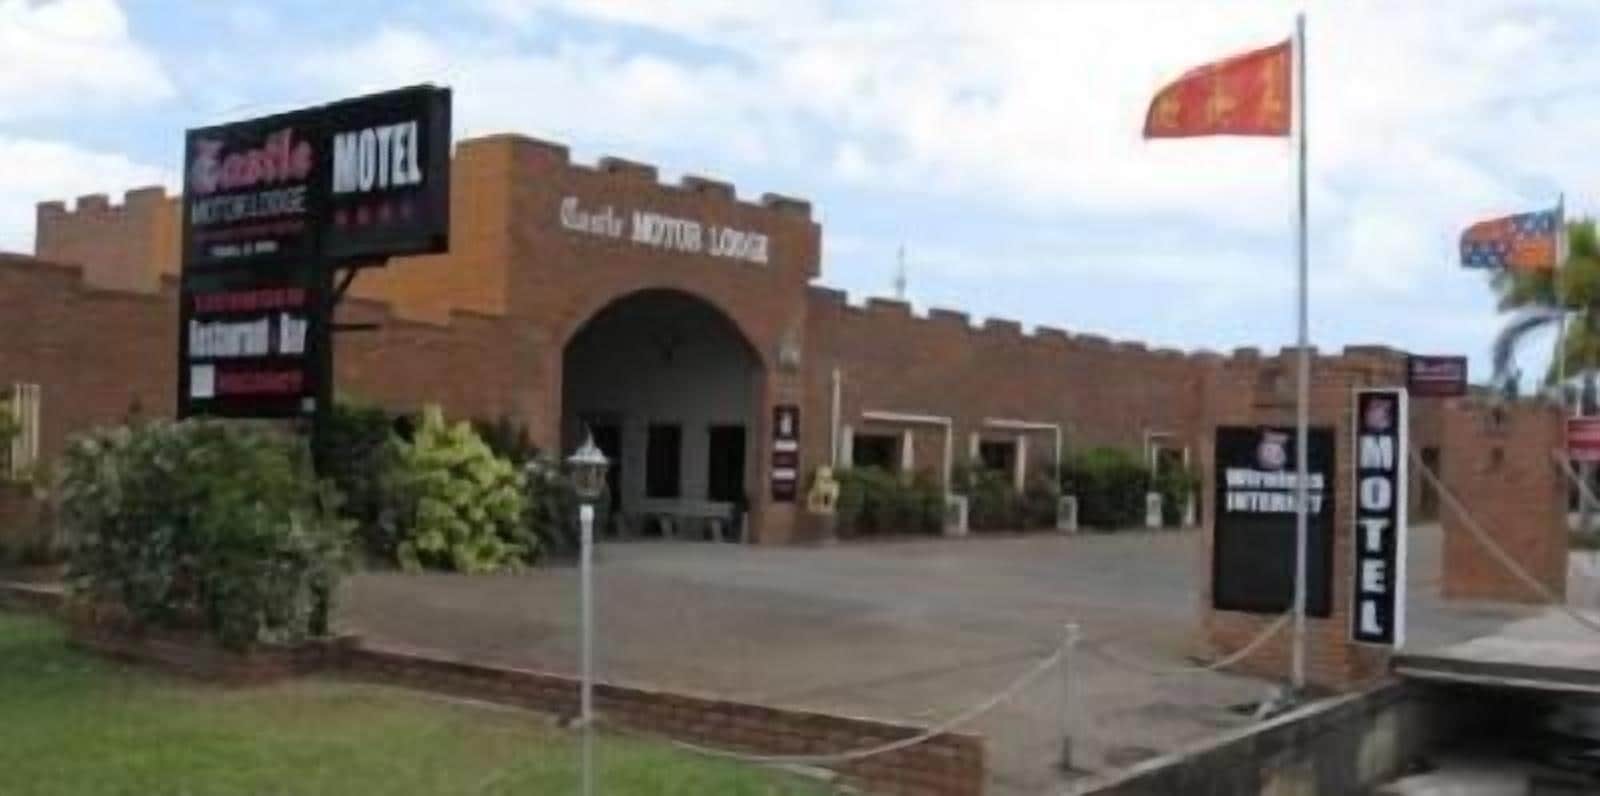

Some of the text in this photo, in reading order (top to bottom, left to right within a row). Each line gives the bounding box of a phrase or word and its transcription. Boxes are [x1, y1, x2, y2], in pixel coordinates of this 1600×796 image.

[333, 120, 421, 193] MOTEL
[1225, 492, 1323, 513] INTERNT
[1358, 433, 1394, 637] MOTEL
